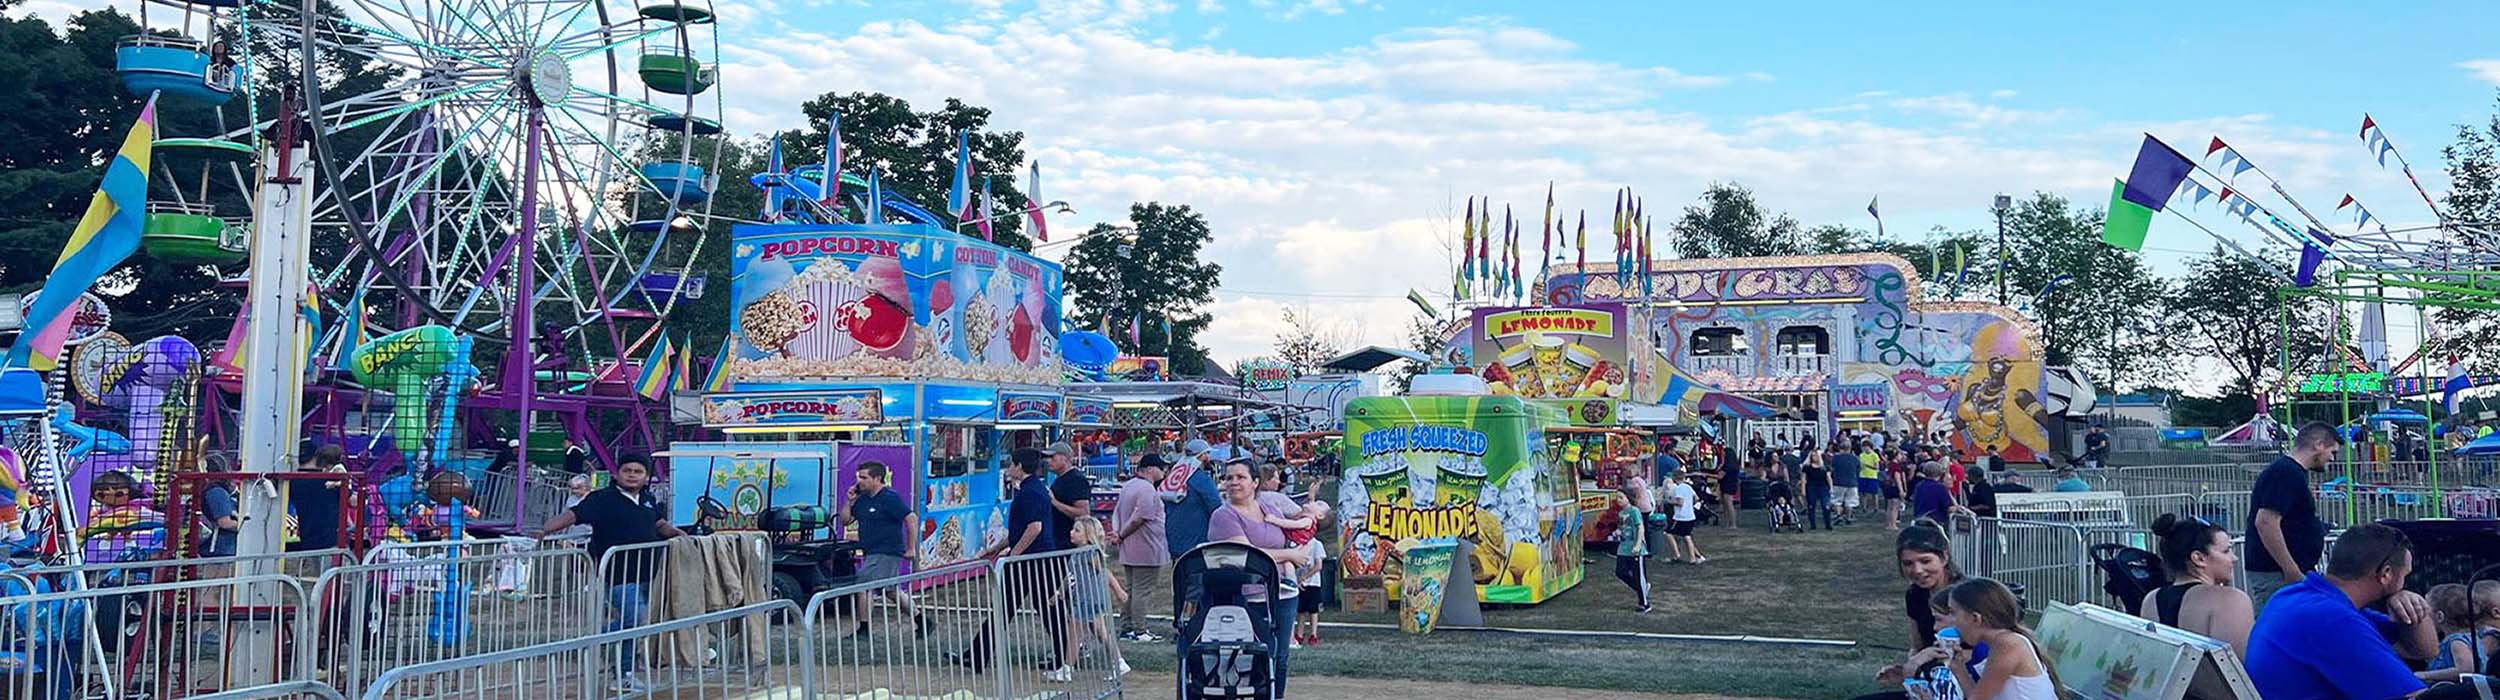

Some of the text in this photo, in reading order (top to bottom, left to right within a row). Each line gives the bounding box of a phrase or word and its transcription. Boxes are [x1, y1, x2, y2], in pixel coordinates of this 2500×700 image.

[761, 236, 899, 262] POPCORN
[954, 246, 1040, 281] COTTON CANDY
[1734, 267, 1859, 298] GRAS
[1501, 316, 1597, 334] LEMONADE
[1254, 368, 1288, 380] REMIX
[742, 401, 838, 418] POPCORN
[1834, 387, 1885, 406] TICKETS
[1361, 424, 1488, 459] FRESH SQUEEZED
[1367, 501, 1479, 542] LEMONADE
